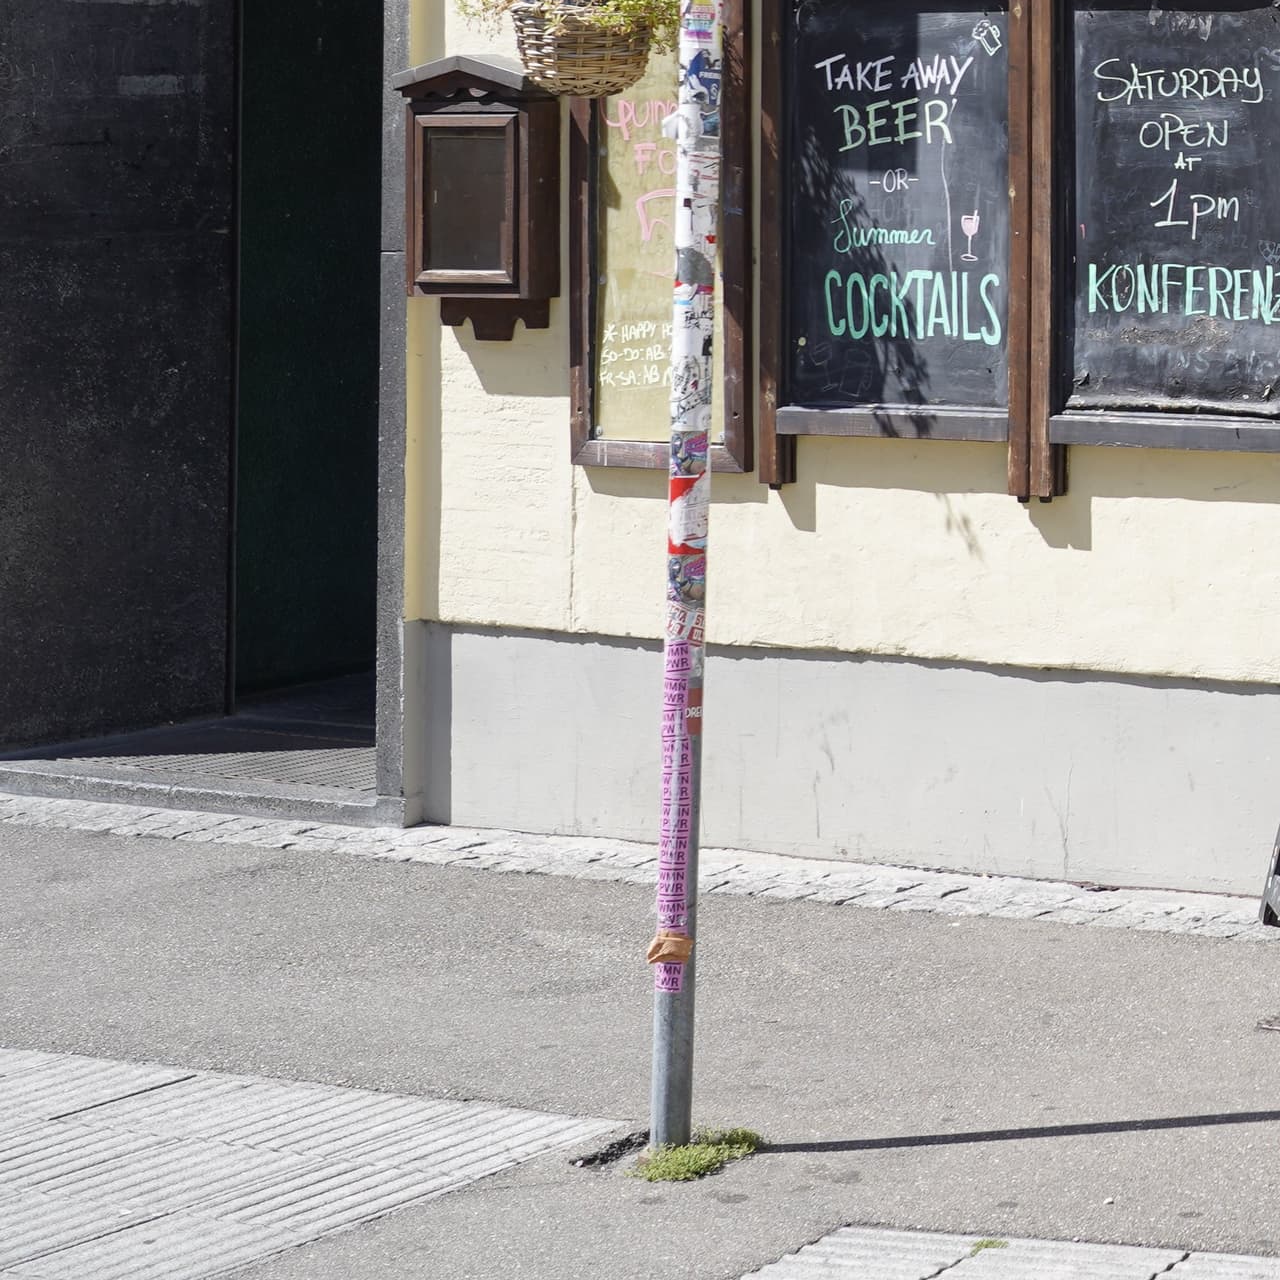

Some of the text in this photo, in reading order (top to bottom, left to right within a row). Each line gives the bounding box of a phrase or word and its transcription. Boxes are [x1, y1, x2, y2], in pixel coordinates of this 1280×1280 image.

[815, 54, 974, 95] TAKE AWAY
[1094, 58, 1265, 103] SATURDAY
[834, 98, 953, 152] BEER
[1139, 113, 1228, 151] OPEN
[1174, 152, 1202, 171] AT
[833, 198, 936, 254] Summer
[825, 269, 1002, 345] COCKTAILS
